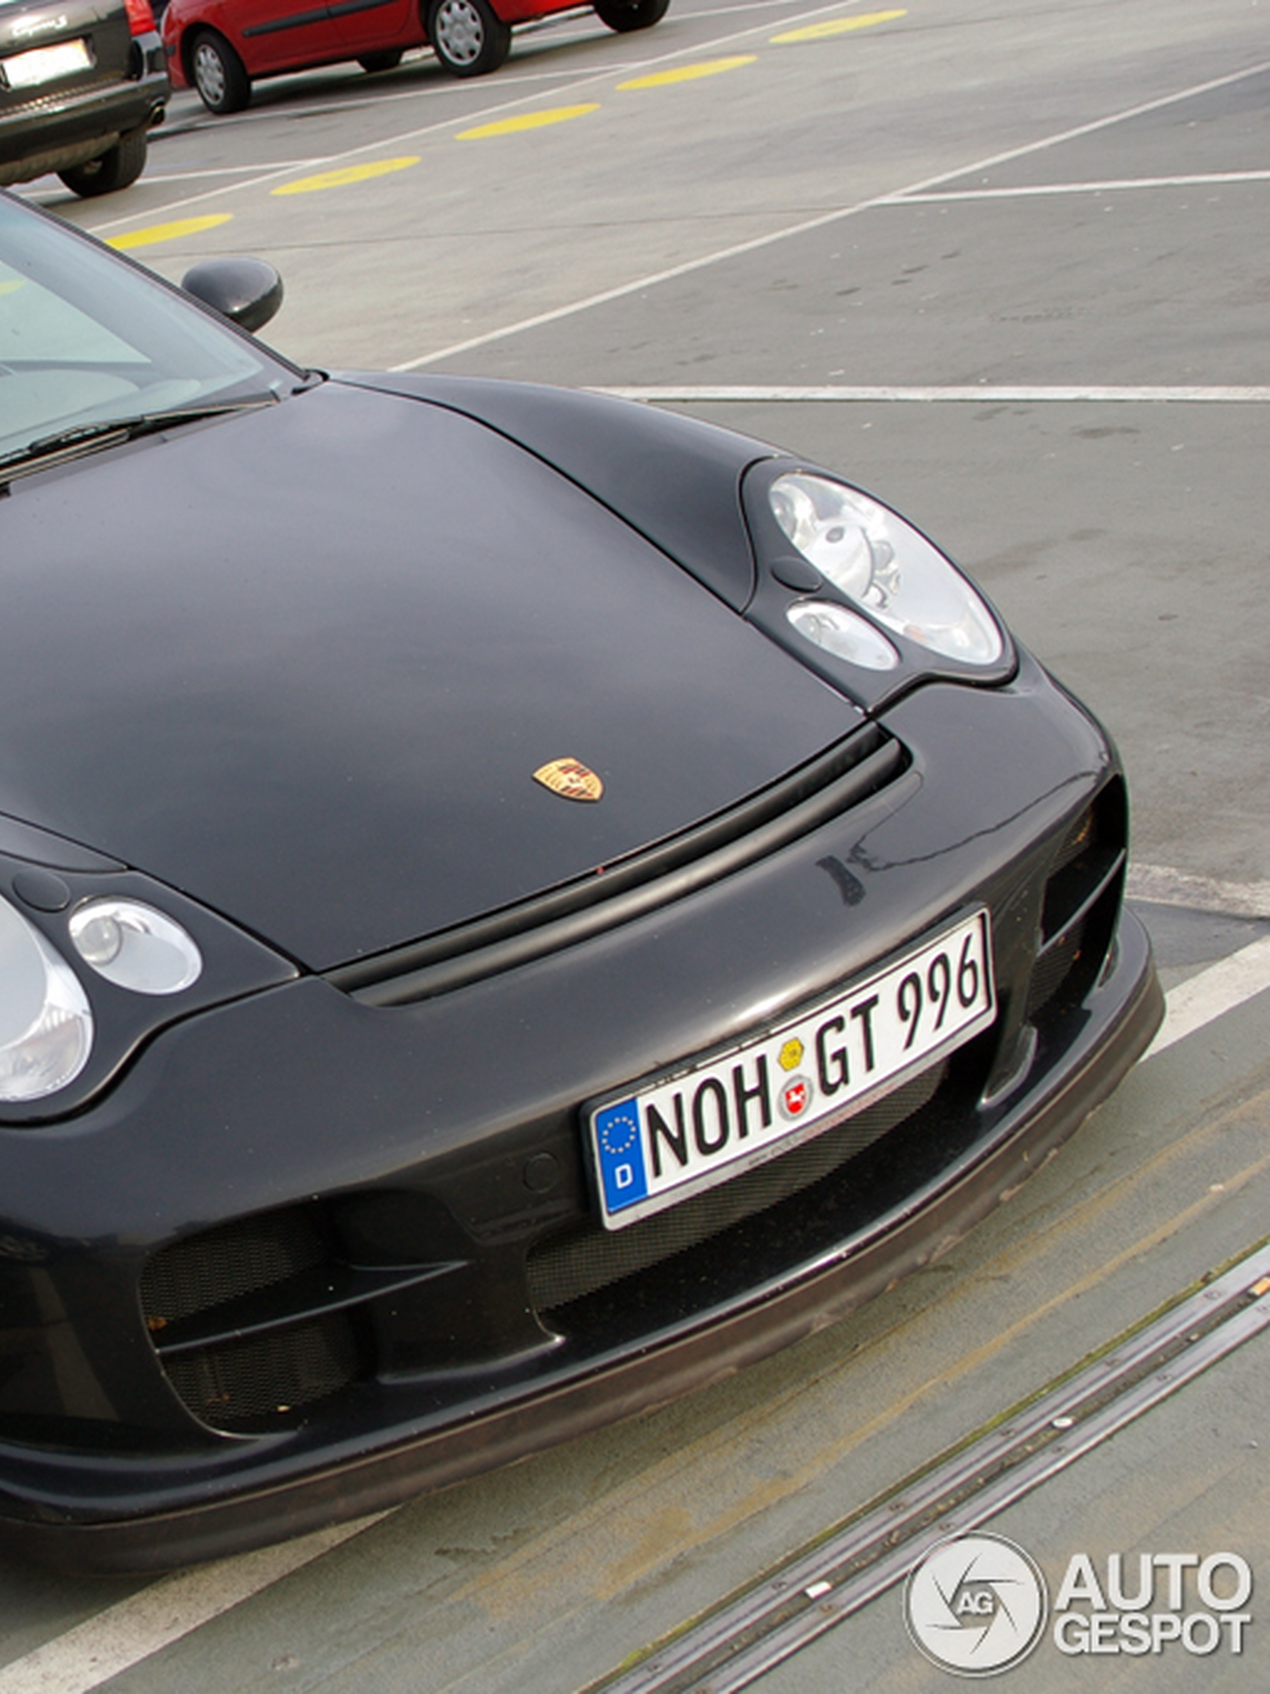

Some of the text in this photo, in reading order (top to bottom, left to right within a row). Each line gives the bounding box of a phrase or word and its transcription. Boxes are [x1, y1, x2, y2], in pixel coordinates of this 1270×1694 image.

[645, 1053, 773, 1179] NOH
[815, 993, 879, 1097] GT
[896, 933, 979, 1052] 996
[614, 1163, 634, 1189] D
